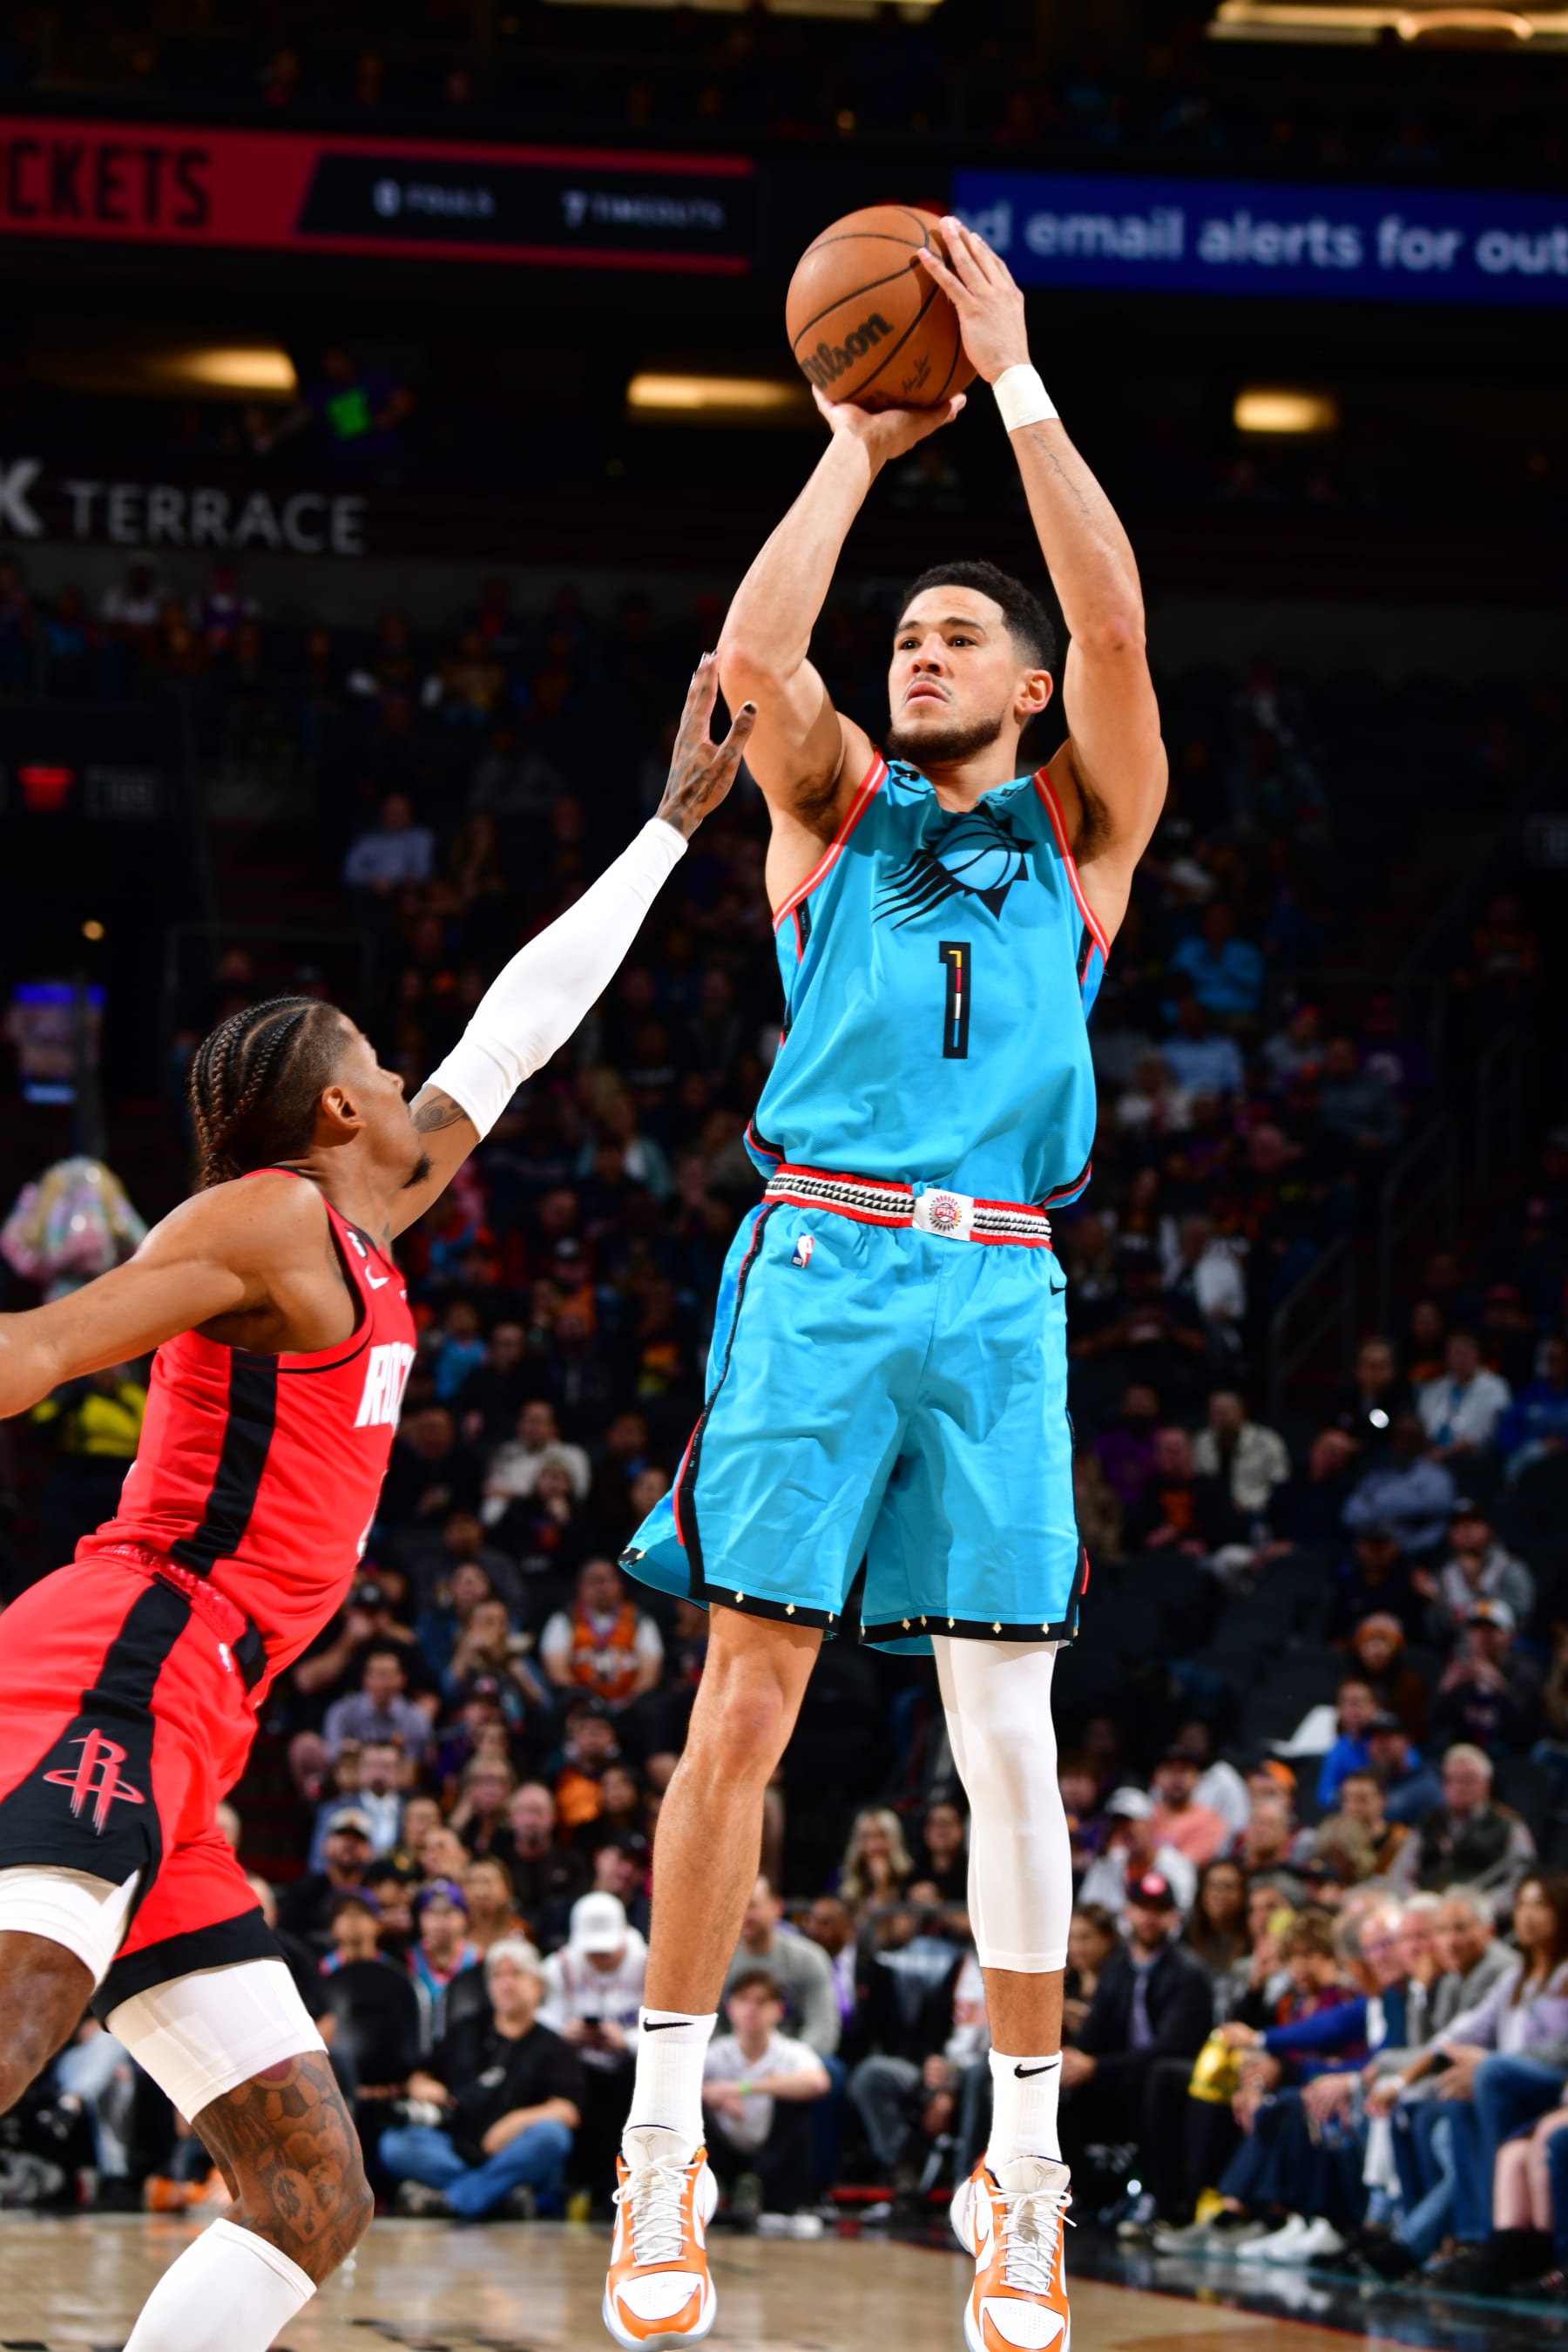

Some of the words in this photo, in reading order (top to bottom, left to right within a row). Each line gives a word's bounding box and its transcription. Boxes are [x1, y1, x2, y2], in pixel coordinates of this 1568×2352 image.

[7, 138, 213, 228] CKETS
[1023, 206, 1185, 259] email
[1197, 211, 1362, 269] alerts
[1376, 214, 1460, 272] for
[66, 478, 368, 554] TERRACE
[938, 941, 970, 1059] 1
[936, 1207, 956, 1220] PHX
